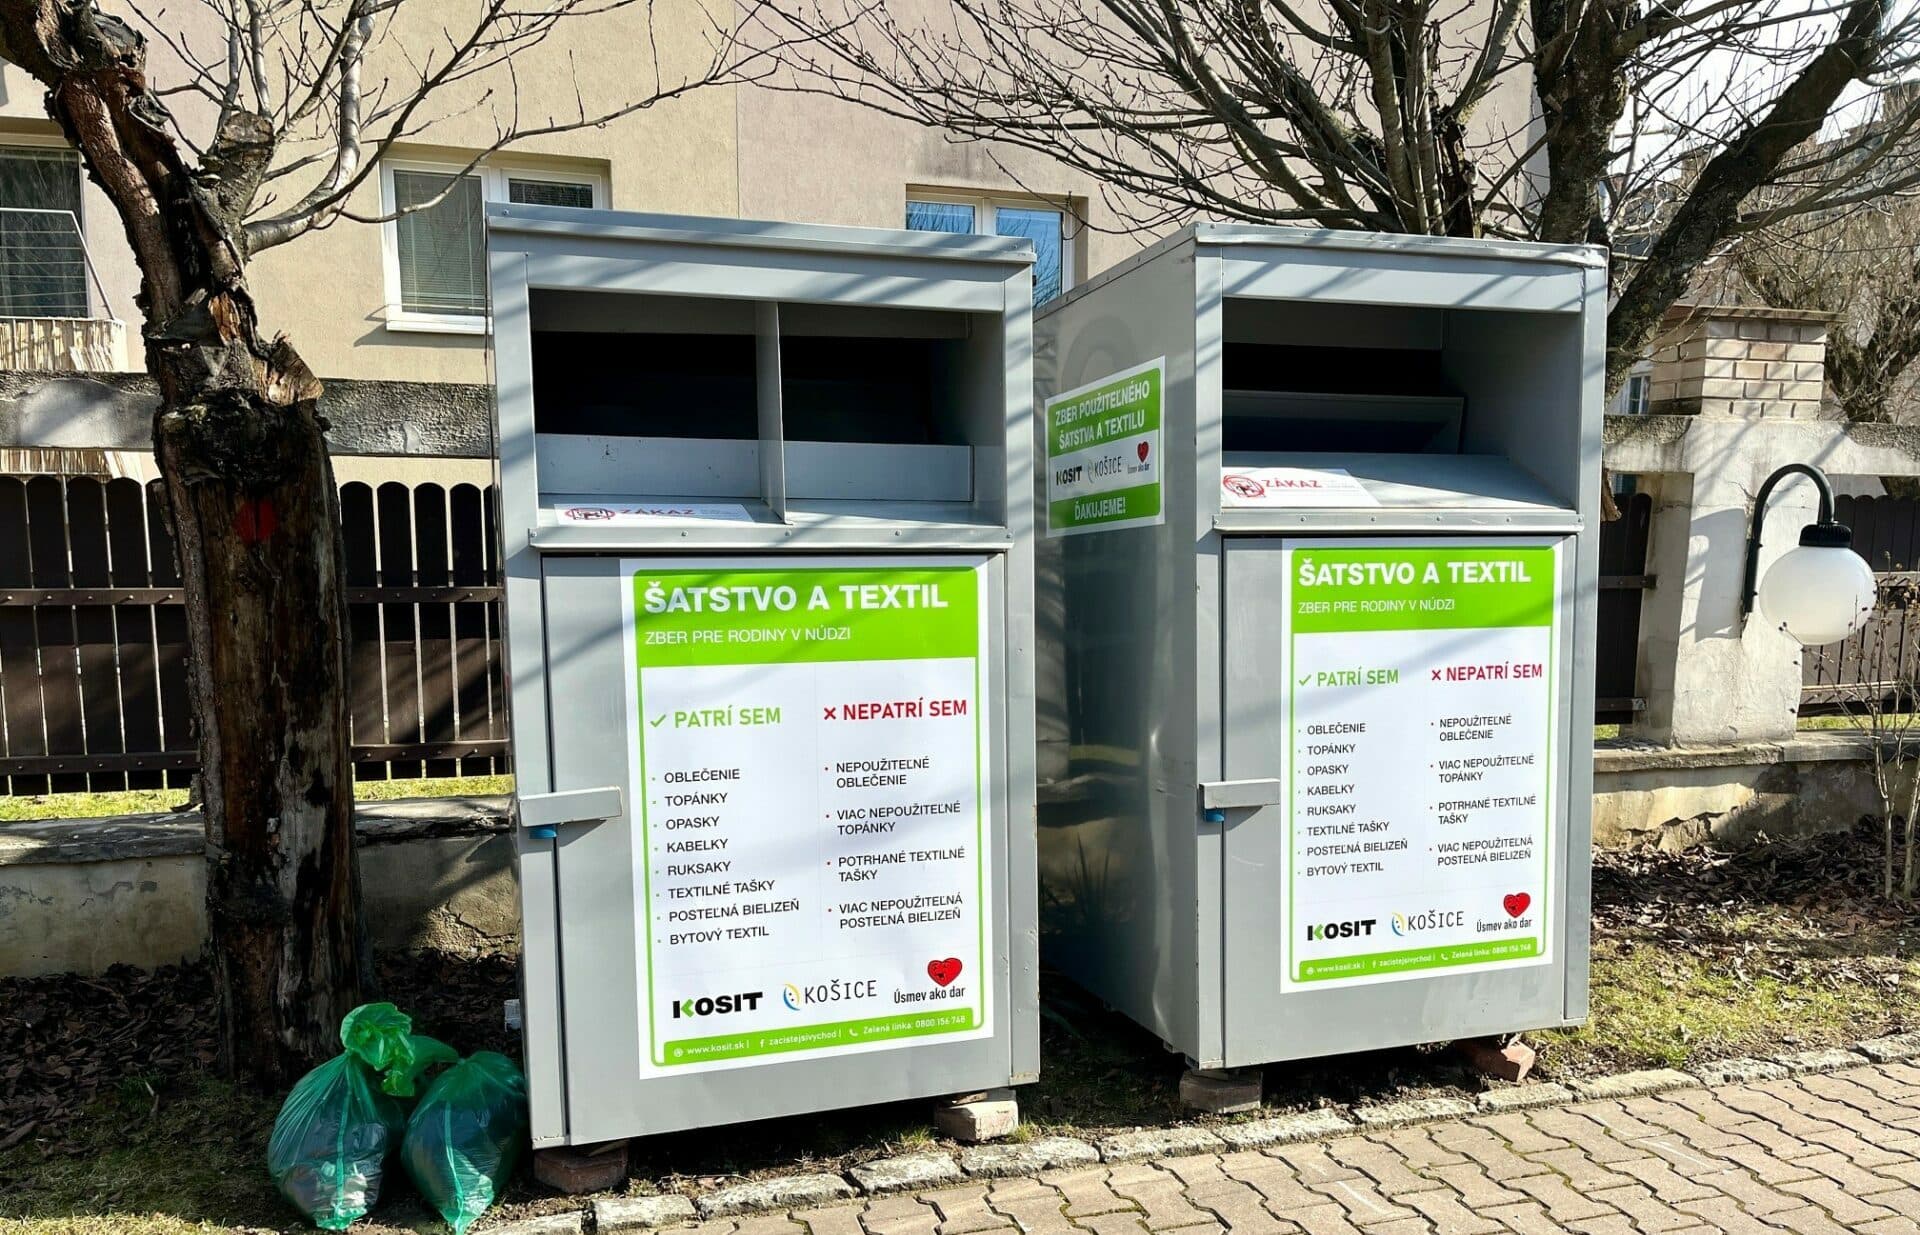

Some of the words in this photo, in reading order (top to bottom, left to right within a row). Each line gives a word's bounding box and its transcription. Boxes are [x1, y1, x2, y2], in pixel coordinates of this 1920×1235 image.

[1055, 409, 1077, 426] ZBER
[1080, 380, 1149, 417] POUŽITEĽNÉHO
[1059, 431, 1094, 449] ŠATSTVA
[1097, 423, 1101, 437] A
[1105, 409, 1144, 436] TEXTILU
[1094, 456, 1122, 477] KOŠICE
[1056, 466, 1082, 485] KOSIT
[1262, 478, 1322, 488] ZÁKAZ
[1074, 498, 1125, 520] ĎAKUJEME!
[1298, 558, 1415, 586] ŠATSTVO
[1422, 563, 1440, 584] A
[1448, 561, 1531, 583] TEXTIL
[644, 581, 797, 613] ŠATSTVO
[808, 587, 829, 611] A
[839, 584, 948, 609] TEXTIL
[1298, 602, 1330, 614] ZBER
[1334, 601, 1356, 612] PRE
[1360, 600, 1406, 612] RODINY
[1409, 600, 1416, 610] V
[1420, 597, 1455, 610] NÚDZI
[645, 631, 687, 645] ZBER
[693, 630, 723, 644] PRE
[728, 629, 787, 642] RODINY
[791, 628, 801, 641] V
[805, 625, 851, 641] NÚDZI
[1317, 667, 1362, 686] PATRÍ
[1367, 669, 1398, 684] SEM
[1446, 662, 1510, 681] NEPATRÍ
[1513, 664, 1542, 678] SEM
[675, 705, 732, 728] PATRÍ
[739, 707, 781, 725] SEM
[843, 697, 924, 721] NEPATRÍ
[929, 699, 967, 717] SEM
[1307, 722, 1366, 735] OBLEČENIE
[1440, 715, 1512, 728] NEPOUŽITEĽNÉ
[1439, 729, 1493, 741] OBLEČENIE
[1307, 744, 1356, 755] TOPÁNKY
[836, 757, 930, 774] NEPOUŽITEĽNÉ
[1307, 764, 1348, 776] OPASKY
[1439, 760, 1462, 770] VIAC
[1463, 754, 1534, 768] NEPOUŽITEĽNÉ
[664, 768, 740, 784] OBLEČENIE
[836, 773, 907, 789] OBLEČENIE
[1438, 771, 1483, 783] TOPÁNKY
[1307, 784, 1354, 796] KABELKY
[665, 792, 728, 807] TOPÁNKY
[1438, 798, 1491, 812] POTRHANÉ
[1492, 796, 1536, 808] TEXTILNÉ
[837, 808, 866, 821] VIAC
[869, 801, 961, 819] NEPOUŽITEĽNÉ
[1307, 804, 1356, 816] RUKSAKY
[1438, 813, 1468, 824] TAŠKY
[666, 816, 720, 831] OPASKY
[837, 821, 896, 835] TOPÁNKY
[1307, 824, 1356, 836] TEXTILNÉ
[1358, 821, 1390, 833] TAŠKY
[666, 839, 728, 854] KABELKY
[1306, 843, 1360, 856] POSTEĽNÁ
[1363, 838, 1408, 852] BIELIZEŇ
[1438, 842, 1460, 853] VIAC
[1462, 836, 1533, 852] NEPOUŽITEĽNÁ
[838, 851, 906, 867] POTRHANÉ
[909, 846, 965, 862] TEXTILNÉ
[1437, 852, 1488, 866] POSTEĽNÁ
[1490, 850, 1532, 862] BIELIZEŇ
[667, 861, 731, 876] RUKSAKY
[838, 868, 878, 882] TAŠKY
[1306, 864, 1347, 876] BYTOVÝ
[1350, 862, 1384, 873] TEXTIL
[668, 882, 731, 899] TEXTILNÉ
[734, 879, 775, 894] TAŠKY
[669, 904, 739, 922] POSTEĽNÁ
[742, 898, 800, 916] BIELIZEŇ
[839, 901, 868, 914] VIAC
[871, 892, 963, 912] NEPOUŽITEĽNÁ
[839, 912, 905, 929] POSTEĽNÁ
[908, 908, 961, 924] BIELIZEŇ
[1408, 910, 1464, 931] KOŠICE
[1476, 919, 1502, 933] Úsmev
[1504, 920, 1518, 930] ako
[1520, 917, 1532, 928] dar
[669, 929, 722, 946] BYTOVÝ
[726, 926, 769, 940] TEXTIL
[1307, 919, 1376, 941] KOSIT
[804, 979, 878, 1004] KOŠICE
[894, 989, 926, 1004] Úsmev
[929, 989, 947, 1001] ako
[950, 986, 966, 999] dar
[672, 991, 763, 1019] KOSIT
[863, 1024, 890, 1034] Zelená
[915, 1019, 934, 1028] 0800
[687, 1042, 744, 1055] www.kosit.sk
